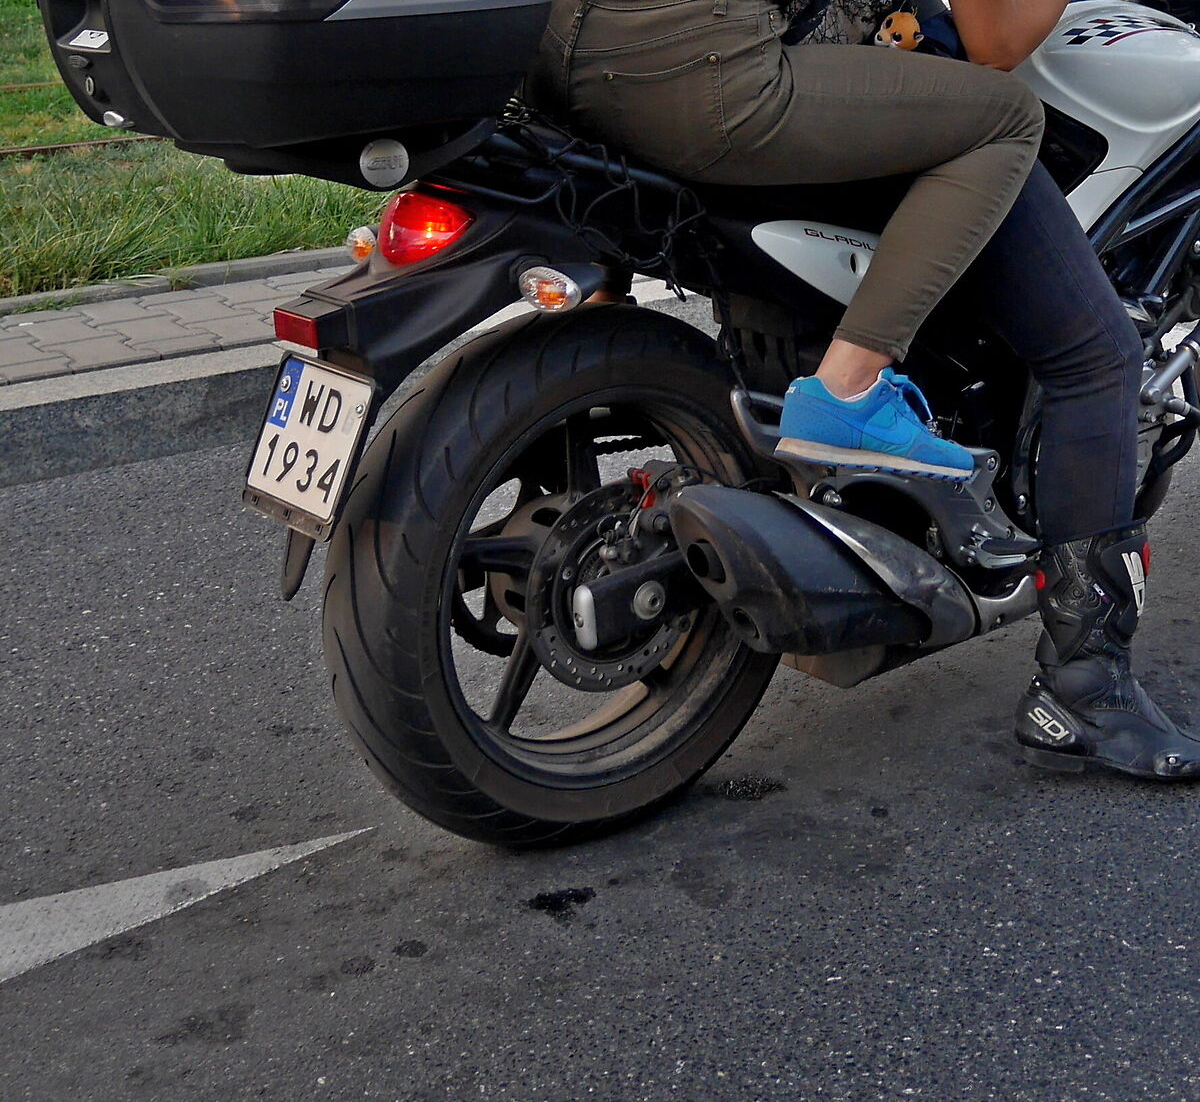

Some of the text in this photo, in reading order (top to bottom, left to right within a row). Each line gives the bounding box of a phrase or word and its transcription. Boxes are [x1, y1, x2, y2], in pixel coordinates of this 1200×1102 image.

[804, 228, 876, 251] GLADIU
[272, 398, 289, 422] PL
[299, 379, 343, 434] WD
[262, 433, 342, 504] 1934
